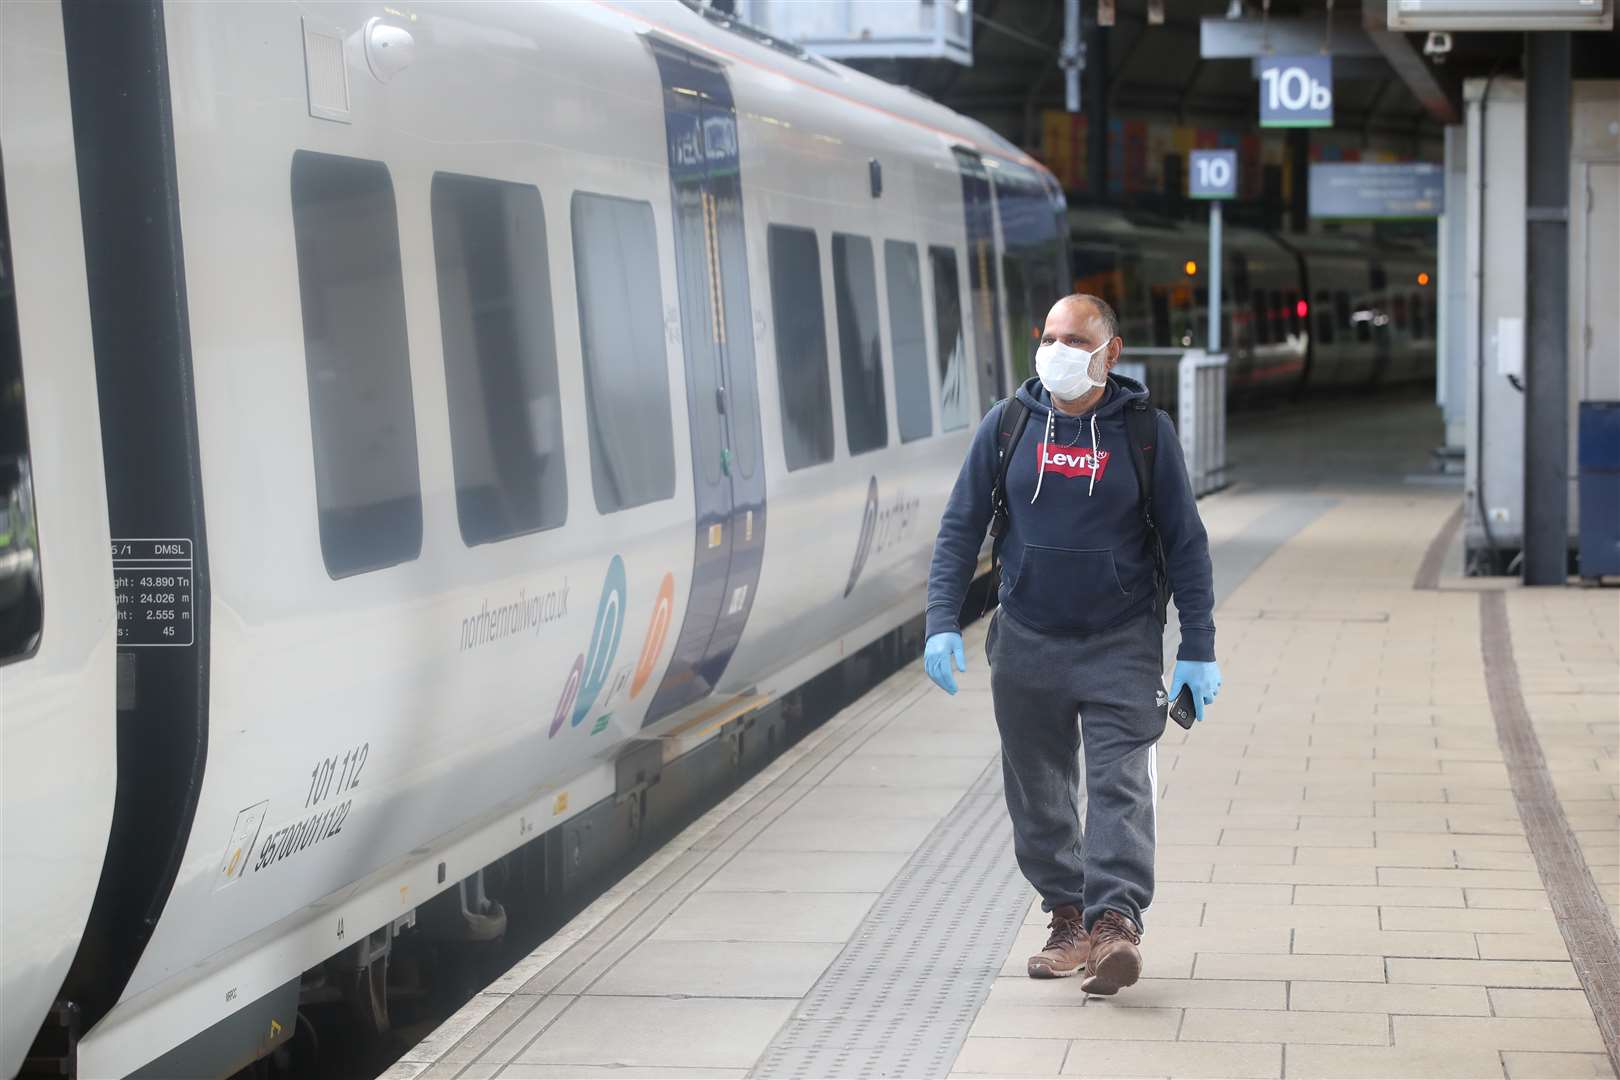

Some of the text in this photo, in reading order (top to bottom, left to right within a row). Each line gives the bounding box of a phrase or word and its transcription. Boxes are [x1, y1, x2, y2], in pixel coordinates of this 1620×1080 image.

[1261, 67, 1332, 111] 10b
[1197, 158, 1231, 188] 10
[154, 545, 185, 555] DMSL
[114, 577, 190, 589] ght: 43.890 Tn
[140, 593, 175, 604] 24.026
[182, 595, 190, 603] m
[117, 610, 190, 620] ht: 2.555 m
[117, 627, 175, 637] s: 45
[305, 742, 369, 808] 101 112
[255, 799, 352, 873] 957001011122
